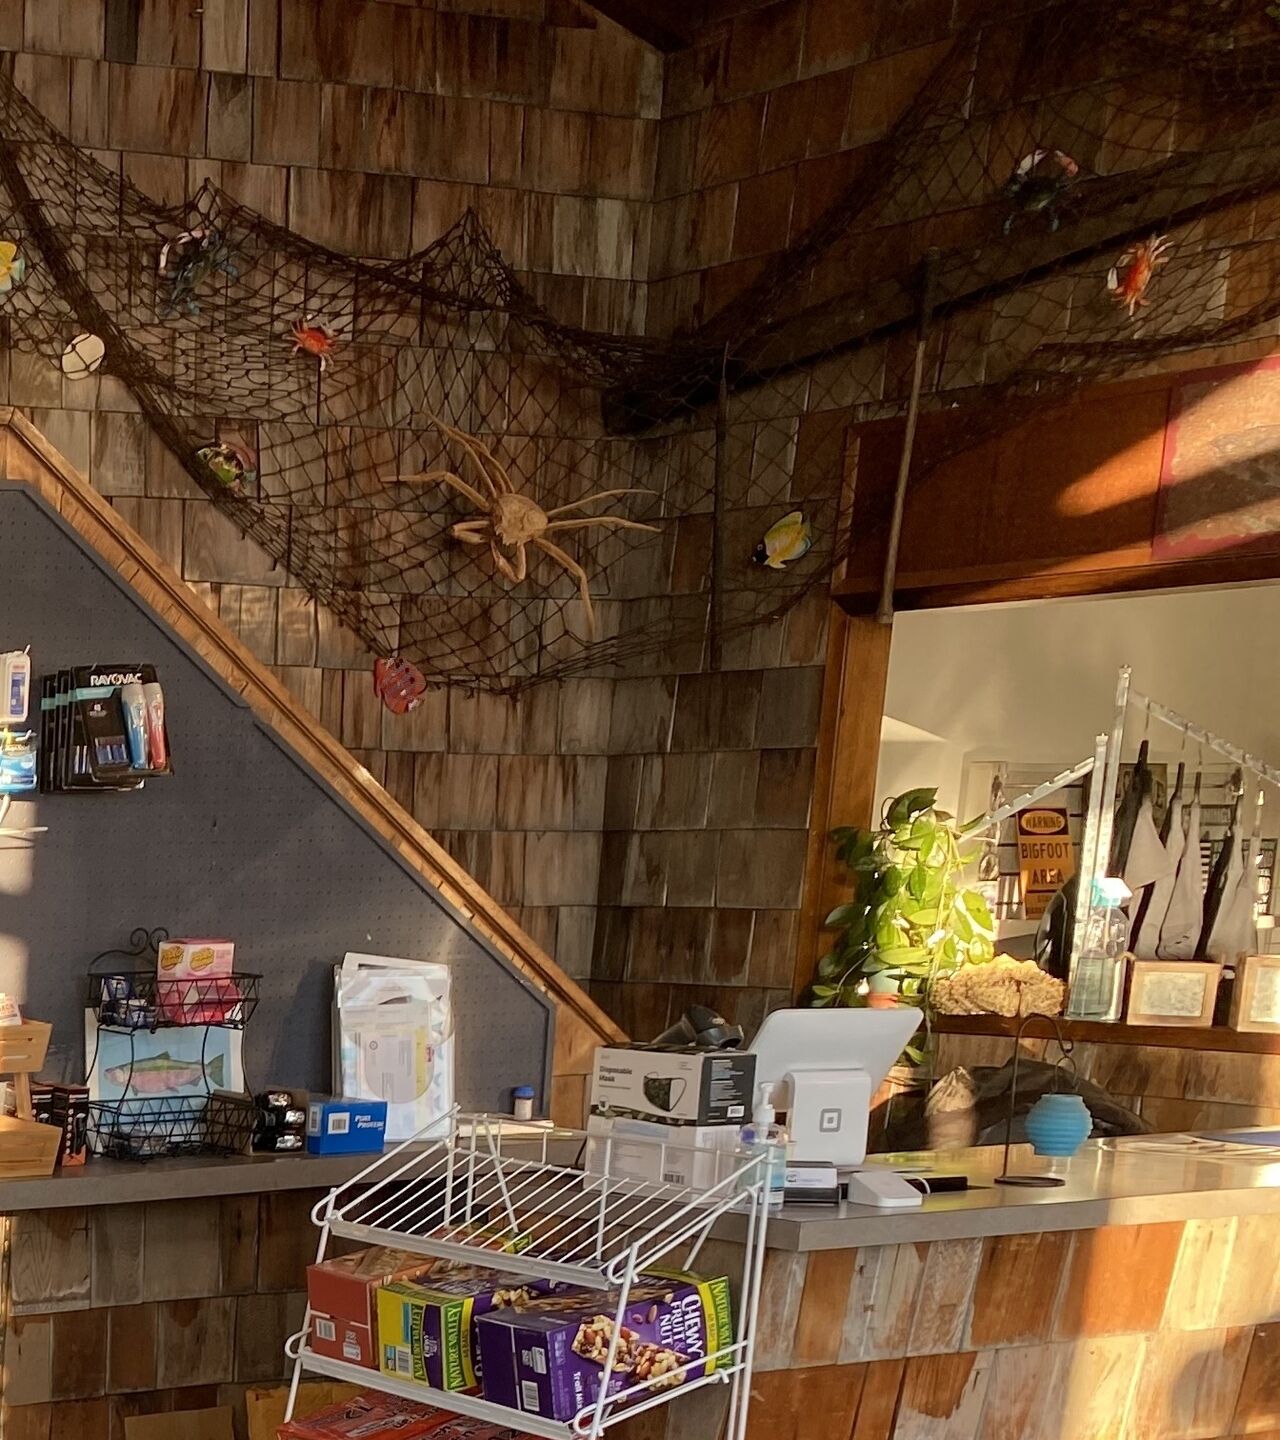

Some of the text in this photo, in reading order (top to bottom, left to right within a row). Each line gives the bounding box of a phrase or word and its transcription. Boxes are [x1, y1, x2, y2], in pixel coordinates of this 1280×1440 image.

[90, 673, 142, 686] RAYOVAC
[1021, 842, 1070, 859] BIGFOOT
[1032, 868, 1065, 884] AREA
[659, 1313, 673, 1345] NUT
[670, 1301, 686, 1340] FRUIT
[681, 1294, 705, 1358] CHEWY
